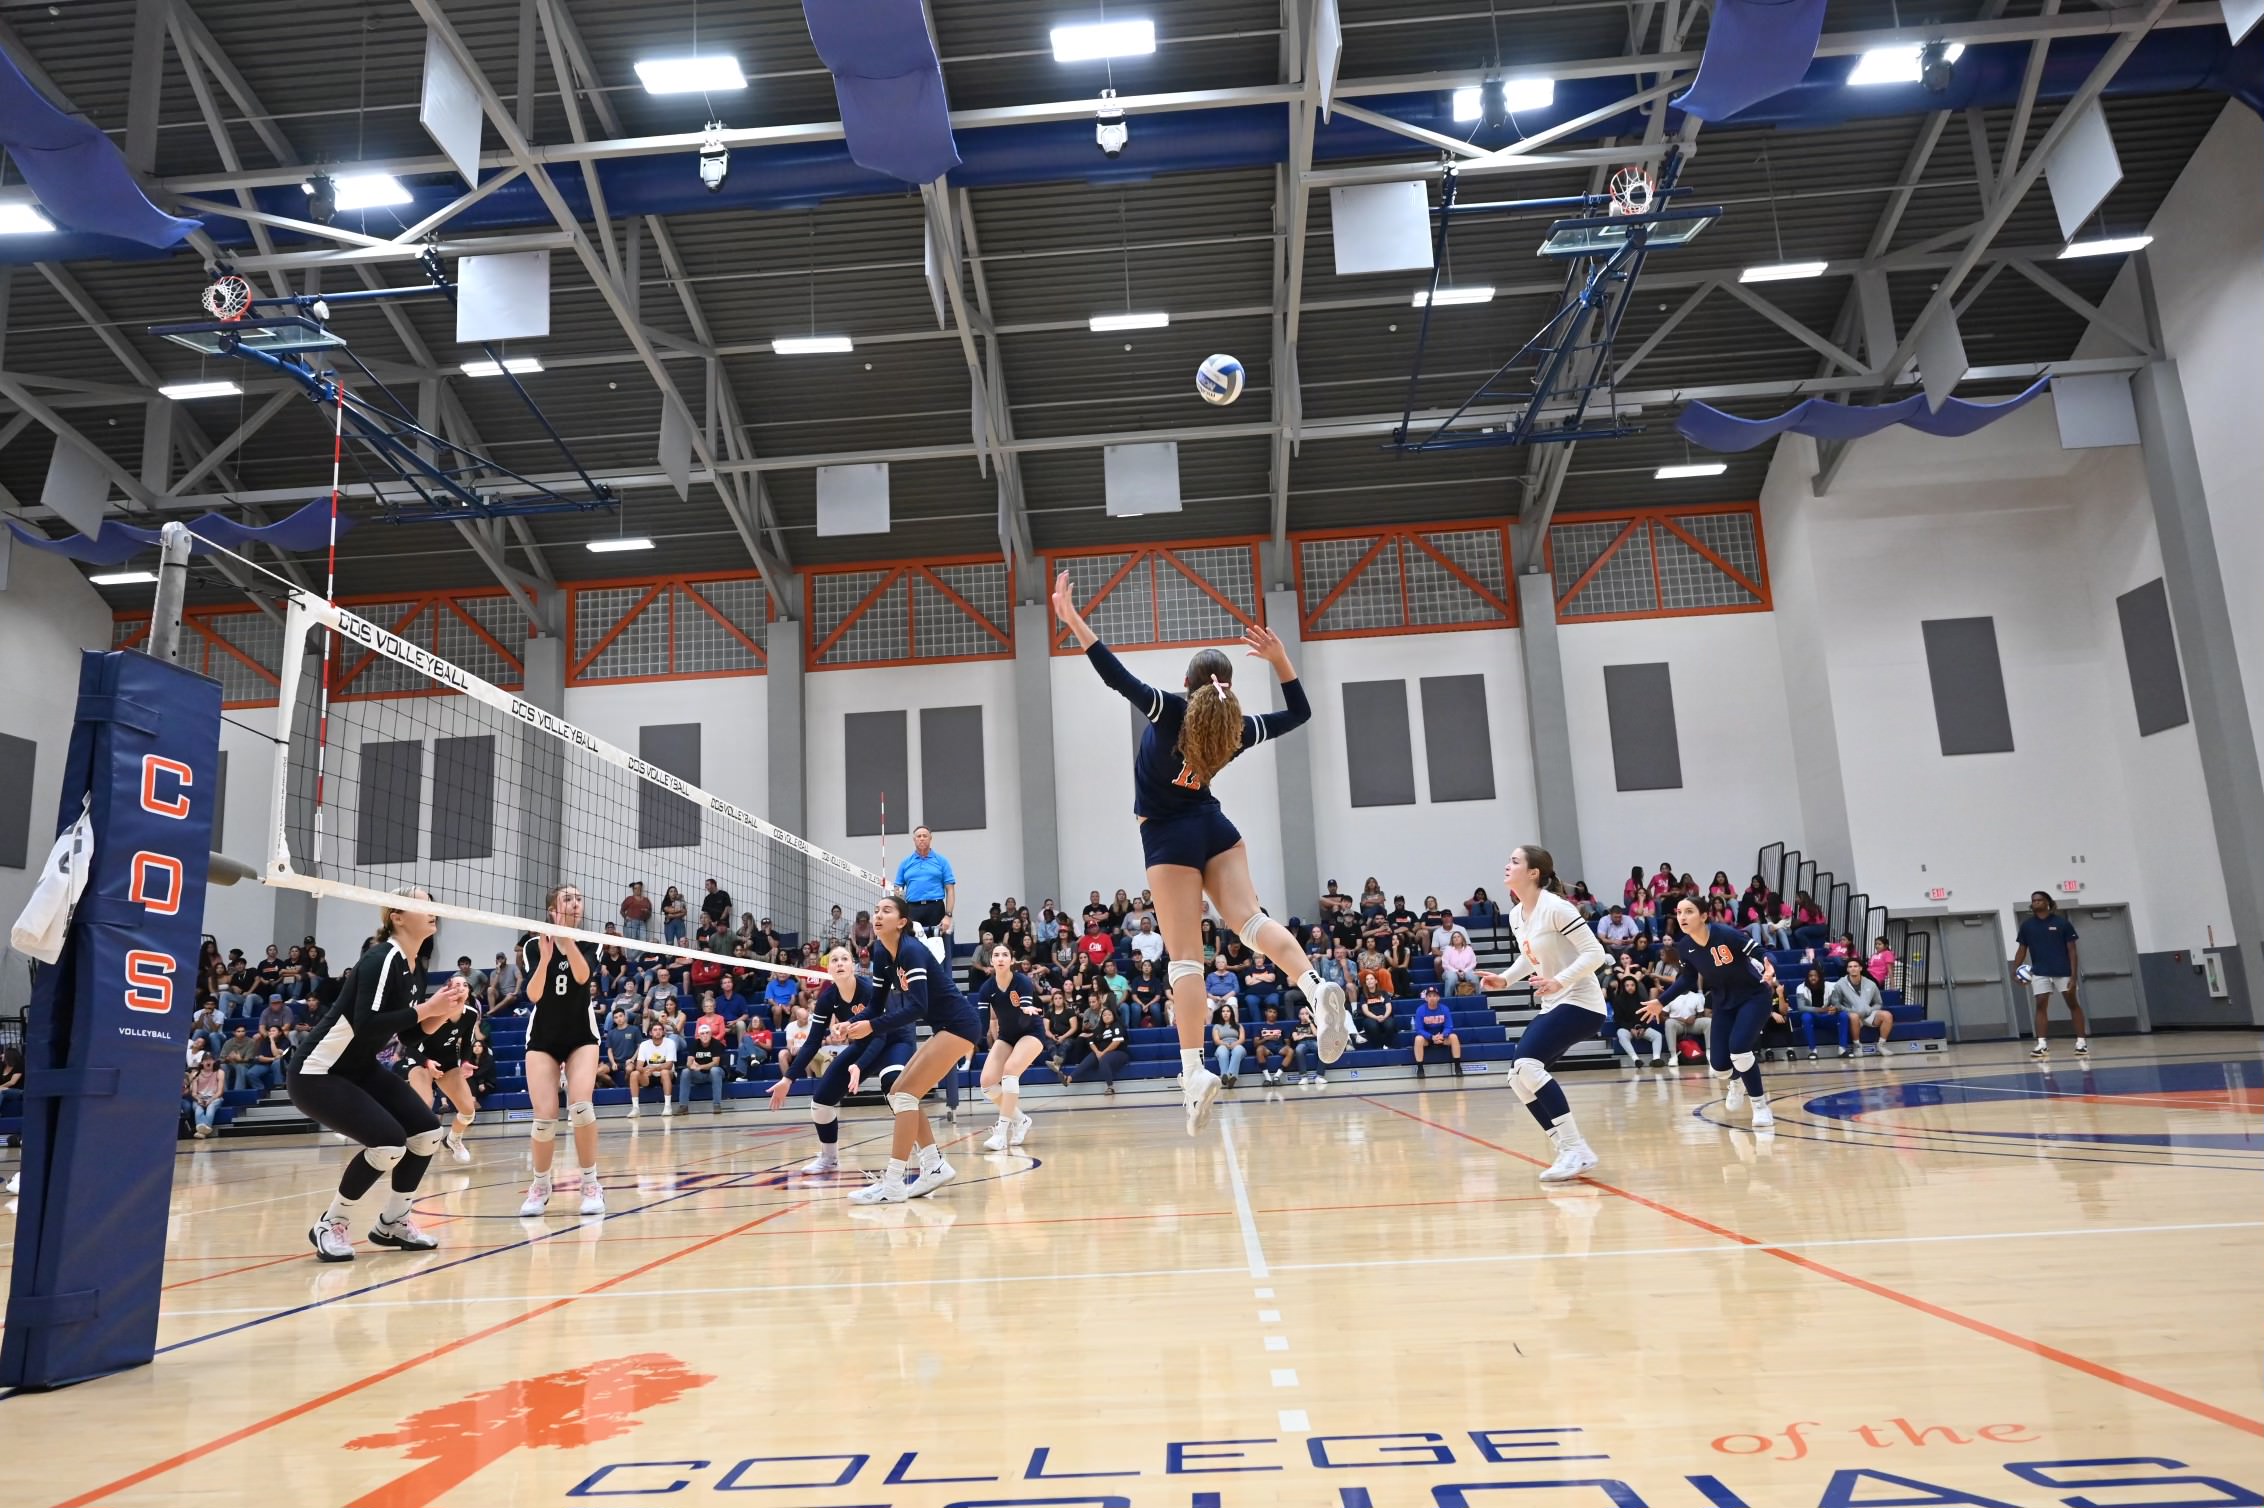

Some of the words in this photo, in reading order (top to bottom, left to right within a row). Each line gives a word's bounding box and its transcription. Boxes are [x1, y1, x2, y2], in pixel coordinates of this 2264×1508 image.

[338, 612, 372, 642] COS
[376, 631, 469, 690] VOLLEYBALL
[512, 700, 535, 722] COS
[538, 711, 599, 753] VOLLEYBALL
[628, 757, 646, 774] COS
[647, 765, 690, 797] VOLLEYBALL
[724, 805, 758, 829] VOLLEYBALL
[1932, 888, 1945, 899] EXIT
[2064, 880, 2077, 890] EXIT
[1710, 944, 1734, 967] 19
[555, 974, 568, 995] 8
[119, 1026, 172, 1040] VOLLEYBALL
[1711, 1421, 1821, 1461] of
[1849, 1417, 2041, 1447] the
[566, 1428, 1610, 1497] COLLEGE
